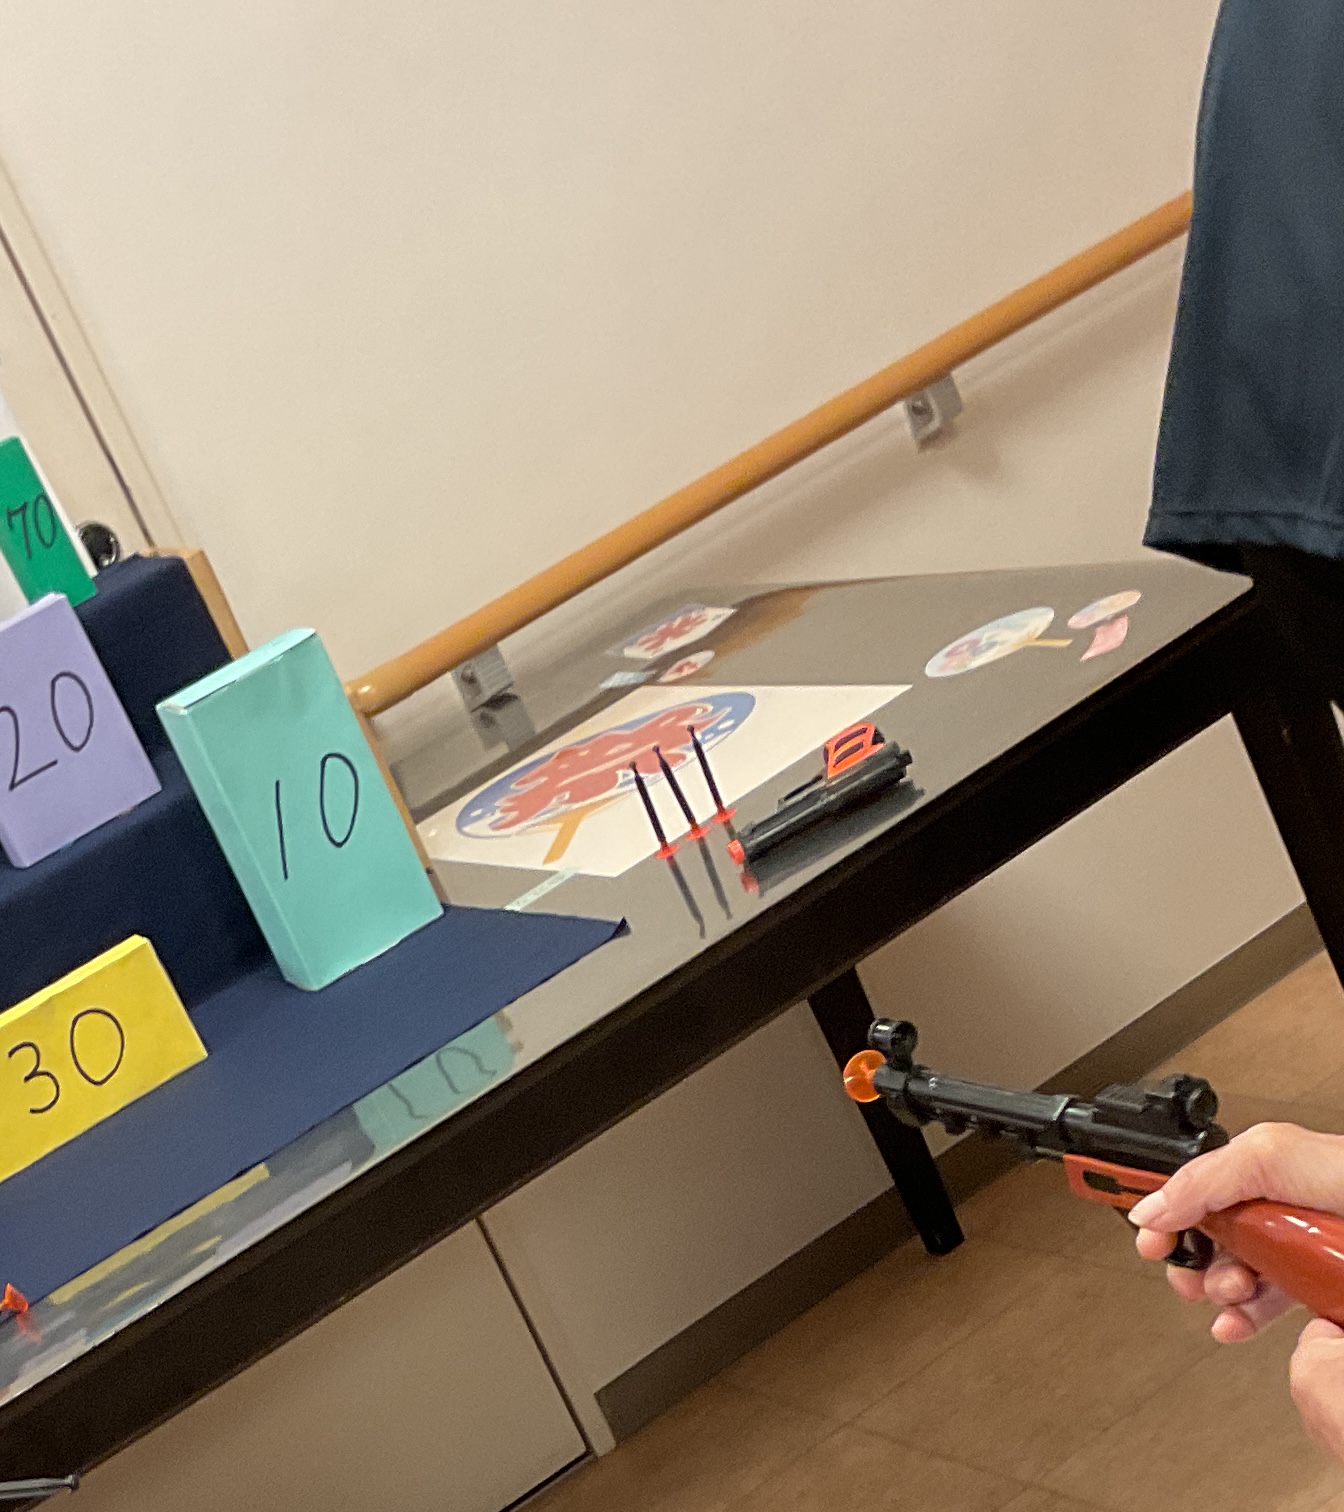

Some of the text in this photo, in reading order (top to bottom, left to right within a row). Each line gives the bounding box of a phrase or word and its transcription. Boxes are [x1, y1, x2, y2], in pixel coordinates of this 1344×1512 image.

[6, 493, 55, 560] 70
[275, 752, 358, 881] 10
[7, 1008, 125, 1114] 30
